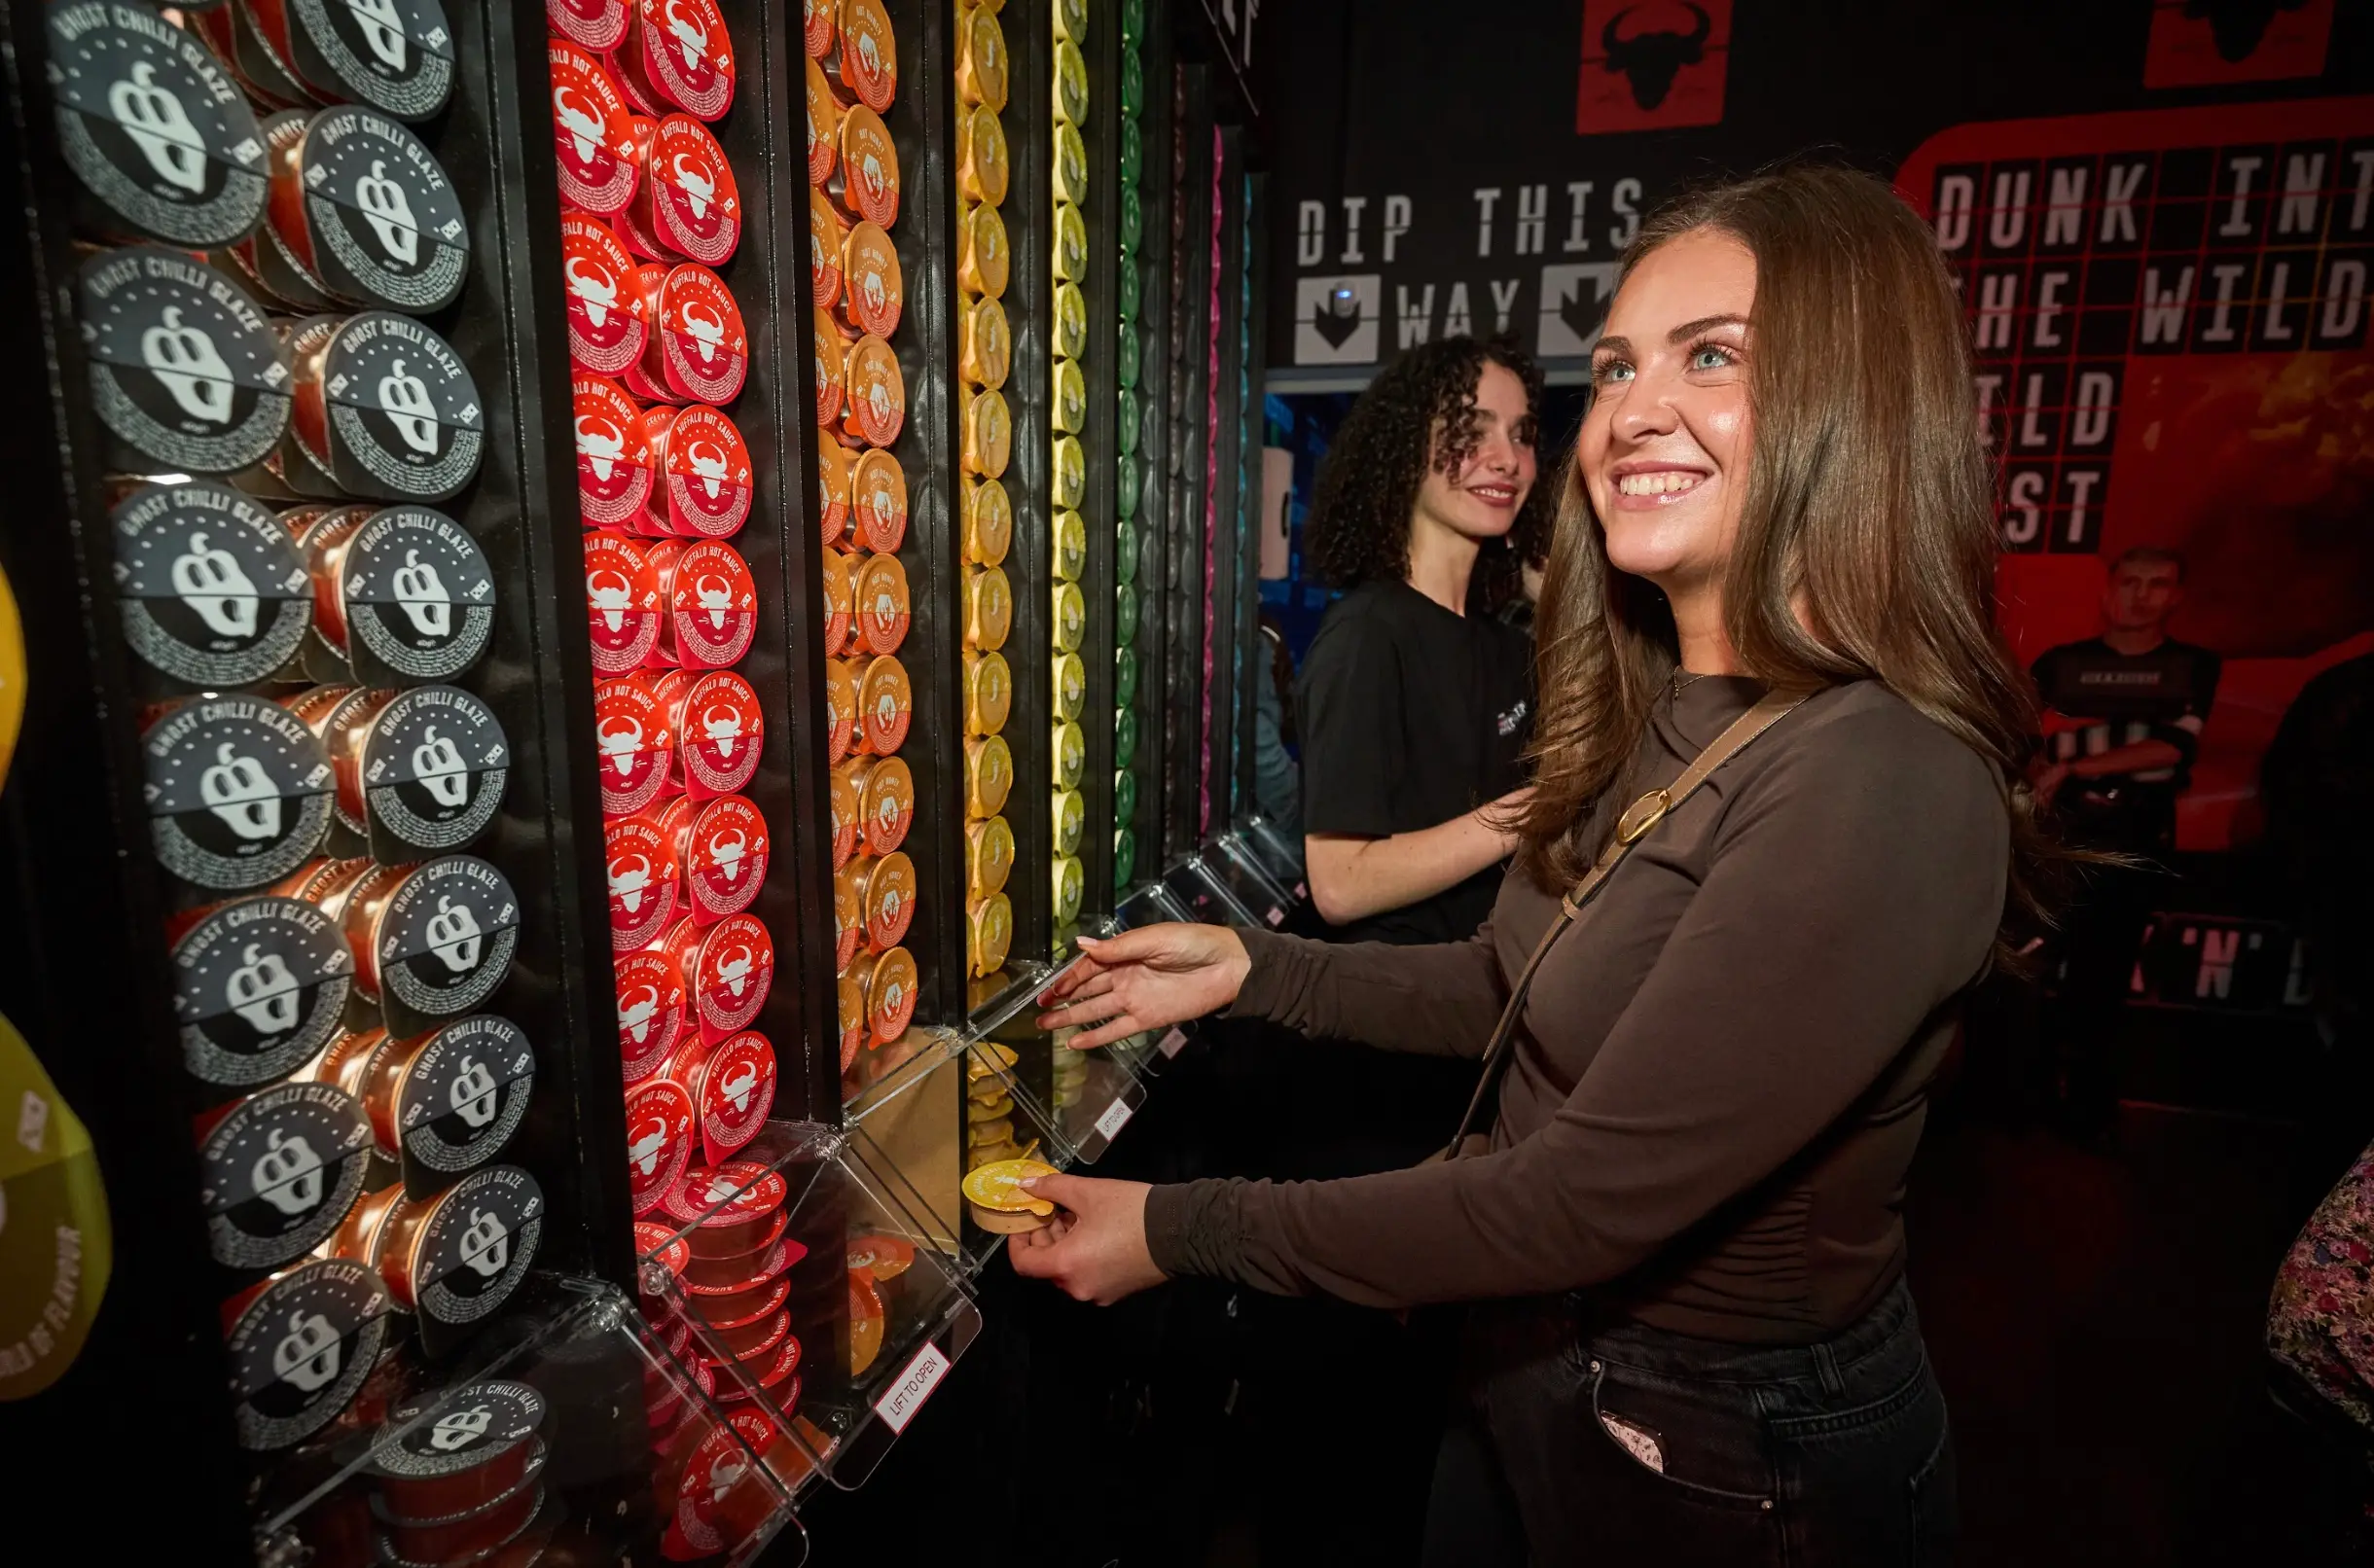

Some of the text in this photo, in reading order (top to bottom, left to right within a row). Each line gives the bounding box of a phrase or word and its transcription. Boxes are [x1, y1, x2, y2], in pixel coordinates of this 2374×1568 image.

[700, 0, 718, 27] AUCE
[549, 49, 620, 113] FALO HOT SAUCE
[807, 86, 818, 104] NEY
[321, 114, 445, 192] GHOST CHILLI GLAZE
[661, 124, 689, 142] BUFFALO
[691, 126, 705, 144] HOT
[705, 140, 725, 173] SAUCE
[810, 209, 825, 229] ONEY
[1936, 150, 2374, 251] DUNK INT
[1297, 178, 1642, 267] DIP THIS
[563, 222, 629, 273] FALO HOT SAUCE
[671, 270, 733, 314] BUFFALO HOT SAUCE
[1975, 261, 2366, 349] HE WILD
[1396, 279, 1520, 350] WAY
[342, 319, 463, 379] GHOST CHILLI GLAZE
[815, 332, 828, 350] ONEY
[592, 383, 609, 400] HOT
[609, 392, 635, 424] SAUCE
[1974, 372, 2114, 447] ILD
[676, 411, 737, 448] BUFFALO HOT SAUCE
[232, 502, 284, 545] GLAZE
[2005, 471, 2100, 544] ST
[359, 513, 475, 559] GHOST CHILLI GLAZE
[602, 538, 619, 552] HOT
[618, 544, 644, 572] SAUCE
[682, 546, 741, 576] BUFFALO HOT SAUCE
[823, 568, 836, 583] NEY
[615, 685, 629, 697] HOT
[630, 689, 656, 713] SAUCE
[694, 677, 751, 707] BUFFALO HOT SAUCE
[258, 706, 307, 745] GLAZE
[333, 696, 367, 731] GHOST
[379, 692, 489, 737] GHOST CHILLI GLAZE
[623, 825, 639, 837] HOT
[638, 827, 663, 848] SAUCE
[698, 802, 755, 836] BUFFALO HOT SAUCE
[393, 861, 500, 913] GHOST CHILLI GLAZE
[280, 903, 327, 935] GLAZE
[706, 919, 762, 956] BUFFALO HOT SAUCE
[631, 957, 648, 970] HOT
[647, 957, 669, 977] SAUCE
[327, 1033, 356, 1067] GHOS
[415, 1020, 515, 1080] GHOST CHILLI GLAZE
[711, 1036, 765, 1078] BUFFALO HOT SAUCE
[305, 1086, 348, 1113] GLAZE
[640, 1089, 677, 1106] HOT SAUCE
[430, 1170, 524, 1238] GHOST CHILLI GLAZE
[651, 1229, 669, 1240] HOT
[486, 1384, 522, 1398] CHILLI
[518, 1393, 540, 1414] GLAZE
[889, 1357, 938, 1416] LIFT TO OPEN
[737, 1415, 751, 1427] HOT
[752, 1418, 769, 1441] SAUCE
